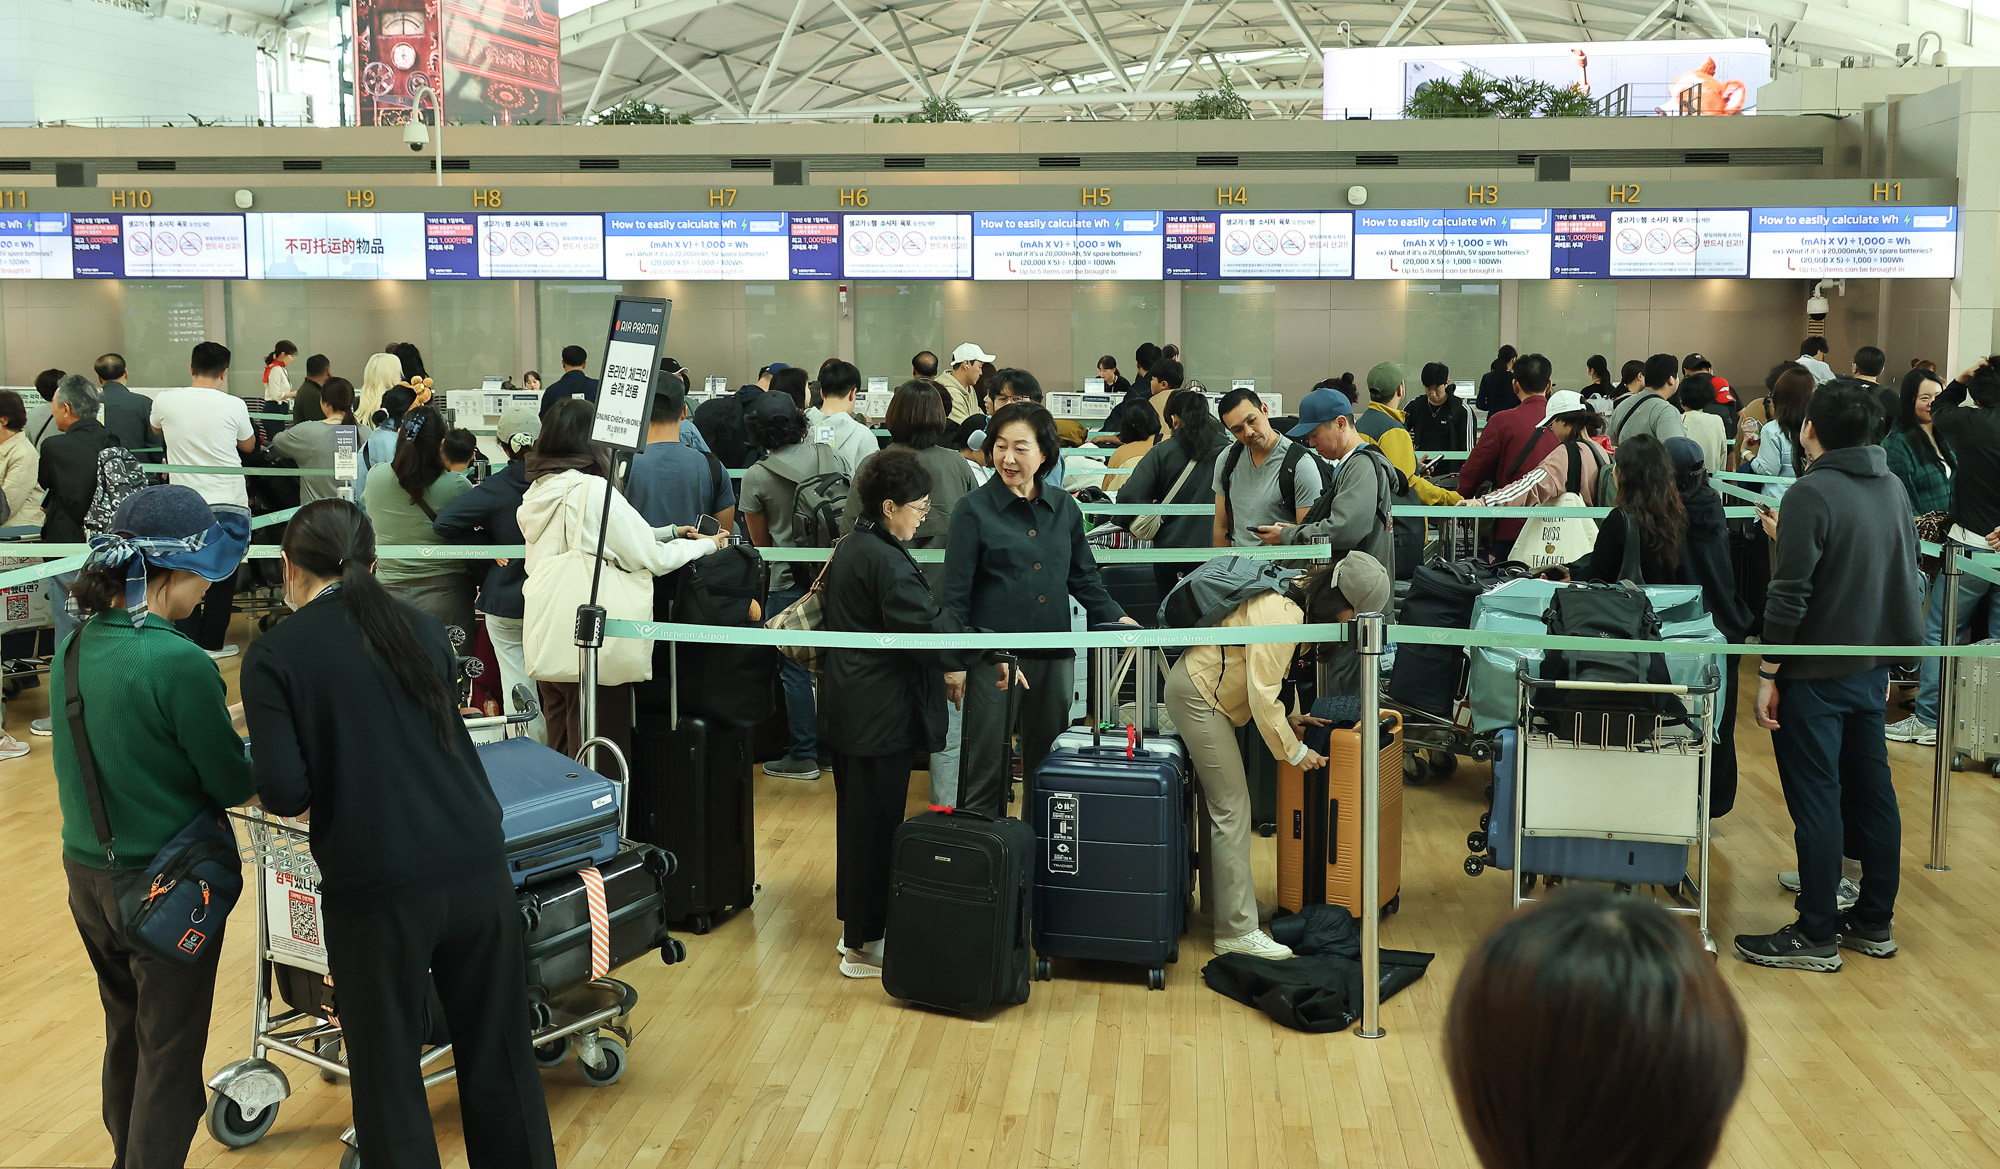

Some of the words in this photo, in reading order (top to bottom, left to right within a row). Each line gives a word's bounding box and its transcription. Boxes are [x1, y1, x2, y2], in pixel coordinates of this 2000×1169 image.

[348, 190, 375, 207] H9
[474, 190, 501, 207] H8
[710, 189, 737, 206] H7
[840, 188, 868, 206] H6
[1082, 188, 1111, 206] H5
[1218, 187, 1247, 205] H4
[1469, 185, 1498, 204] H3
[1610, 184, 1641, 203] H2
[1873, 182, 1901, 201] H1
[0, 190, 27, 208] 11
[112, 190, 151, 208] H10
[7, 220, 22, 229] Wh
[612, 220, 634, 229] How
[635, 220, 646, 229] to
[647, 220, 675, 230] easily
[677, 219, 719, 229] calculate
[722, 219, 737, 229] Wh
[981, 219, 1004, 228] How
[1005, 220, 1016, 228] to
[1018, 219, 1046, 229] easily
[1048, 218, 1092, 228] calculate
[1094, 218, 1110, 228] Wh
[1362, 218, 1386, 227] How
[1388, 218, 1398, 227] to
[1400, 217, 1430, 228] easily
[1432, 217, 1478, 226] calculate
[1480, 217, 1496, 226] Wh
[1759, 216, 1784, 225] How
[1785, 216, 1797, 225] to
[1799, 215, 1830, 226] easily
[1832, 214, 1880, 224] calculate
[1882, 214, 1899, 224] Wh
[285, 238, 384, 254] 不可托运的物品
[650, 241, 673, 249] (mAh
[701, 240, 726, 249] 1,000
[1020, 240, 1044, 248] (mAh
[1053, 240, 1063, 248] V)
[1073, 240, 1098, 250] 1,000
[1108, 240, 1122, 248] Wh
[1403, 239, 1427, 247] (mAh
[1437, 238, 1448, 248] V)
[1458, 239, 1484, 248] 1,000
[1494, 239, 1508, 247] Wh
[1801, 238, 1826, 246] (mAh
[1837, 237, 1848, 246] V)
[1858, 237, 1886, 246] 1,000
[1896, 237, 1910, 245] Wh
[620, 321, 632, 332] AIR
[632, 322, 659, 335] PREMIA
[608, 364, 628, 380] 온라인
[628, 367, 648, 383] 체크인
[610, 383, 624, 397] 승객
[625, 384, 639, 398] 전용
[596, 413, 610, 421] ONLINE
[611, 415, 630, 424] CHECK-IN
[1542, 526, 1560, 540] BOSS.
[660, 630, 694, 639] Incheon
[697, 631, 730, 642] Airport
[1144, 635, 1180, 643] Incheon
[1182, 635, 1214, 643] Airport
